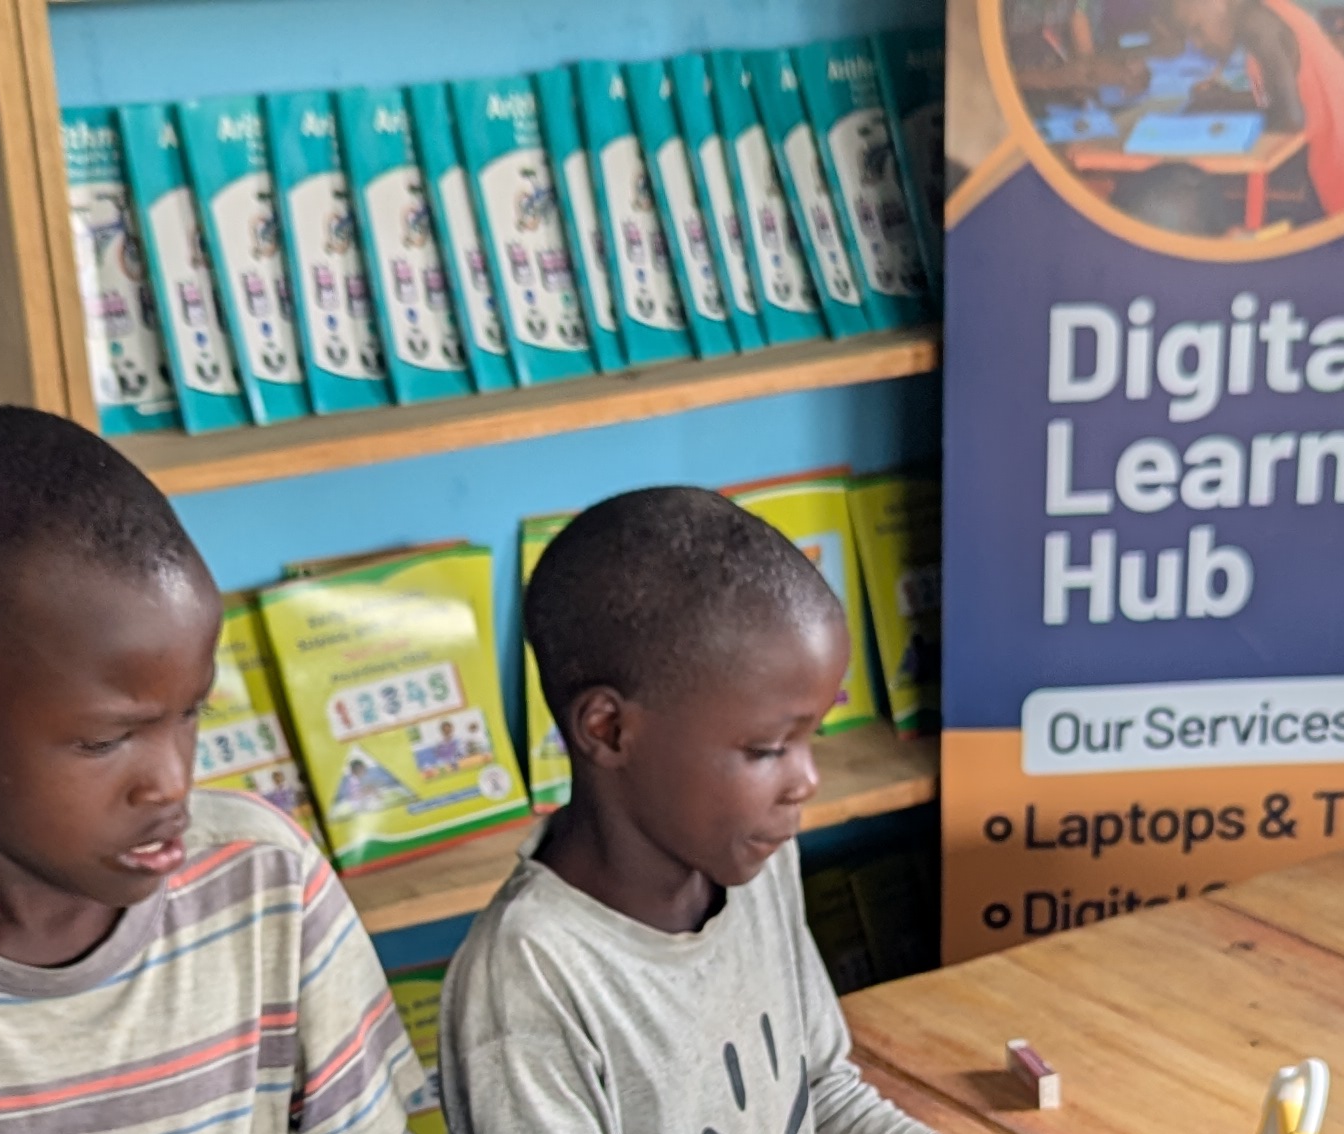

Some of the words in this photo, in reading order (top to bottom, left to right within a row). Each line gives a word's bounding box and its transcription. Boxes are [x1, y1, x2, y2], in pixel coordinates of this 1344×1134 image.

[1042, 523, 1255, 626] Hub
[1047, 710, 1134, 755] Our
[1024, 802, 1246, 859] Laptops
[1257, 792, 1298, 840] &
[1023, 882, 1188, 937] Digit
